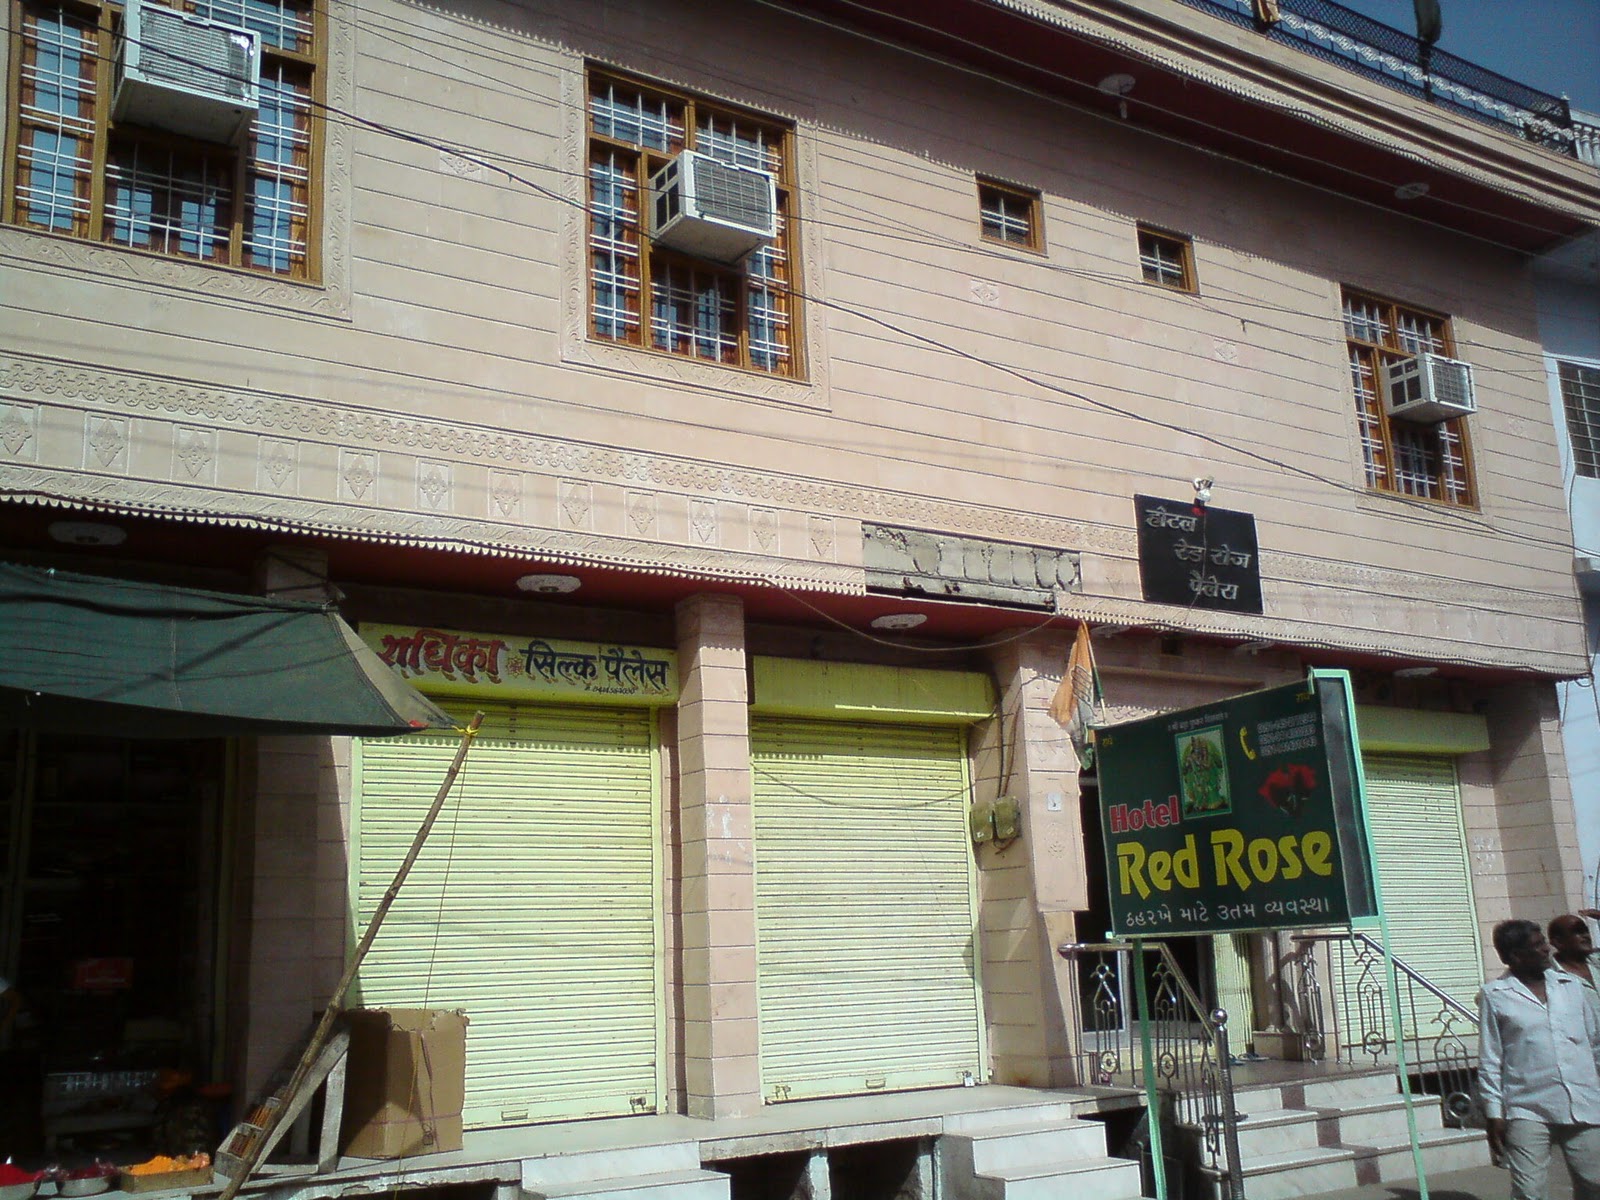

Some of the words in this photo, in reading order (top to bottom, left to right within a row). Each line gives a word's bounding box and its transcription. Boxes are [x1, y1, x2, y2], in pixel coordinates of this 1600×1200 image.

[1145, 506, 1197, 532] होटल
[1174, 538, 1205, 562] रेड
[1211, 544, 1251, 568] रोज
[1190, 570, 1239, 600] पैलेस
[377, 629, 509, 681] राधिका
[519, 640, 598, 678] सिल्क
[601, 647, 670, 687] पैलेस
[1109, 796, 1180, 833] Hotel
[1117, 834, 1200, 900] Red
[1210, 828, 1333, 891] Rose
[1180, 900, 1212, 922] માટે
[1265, 896, 1330, 915] વ્યવસ્થા
